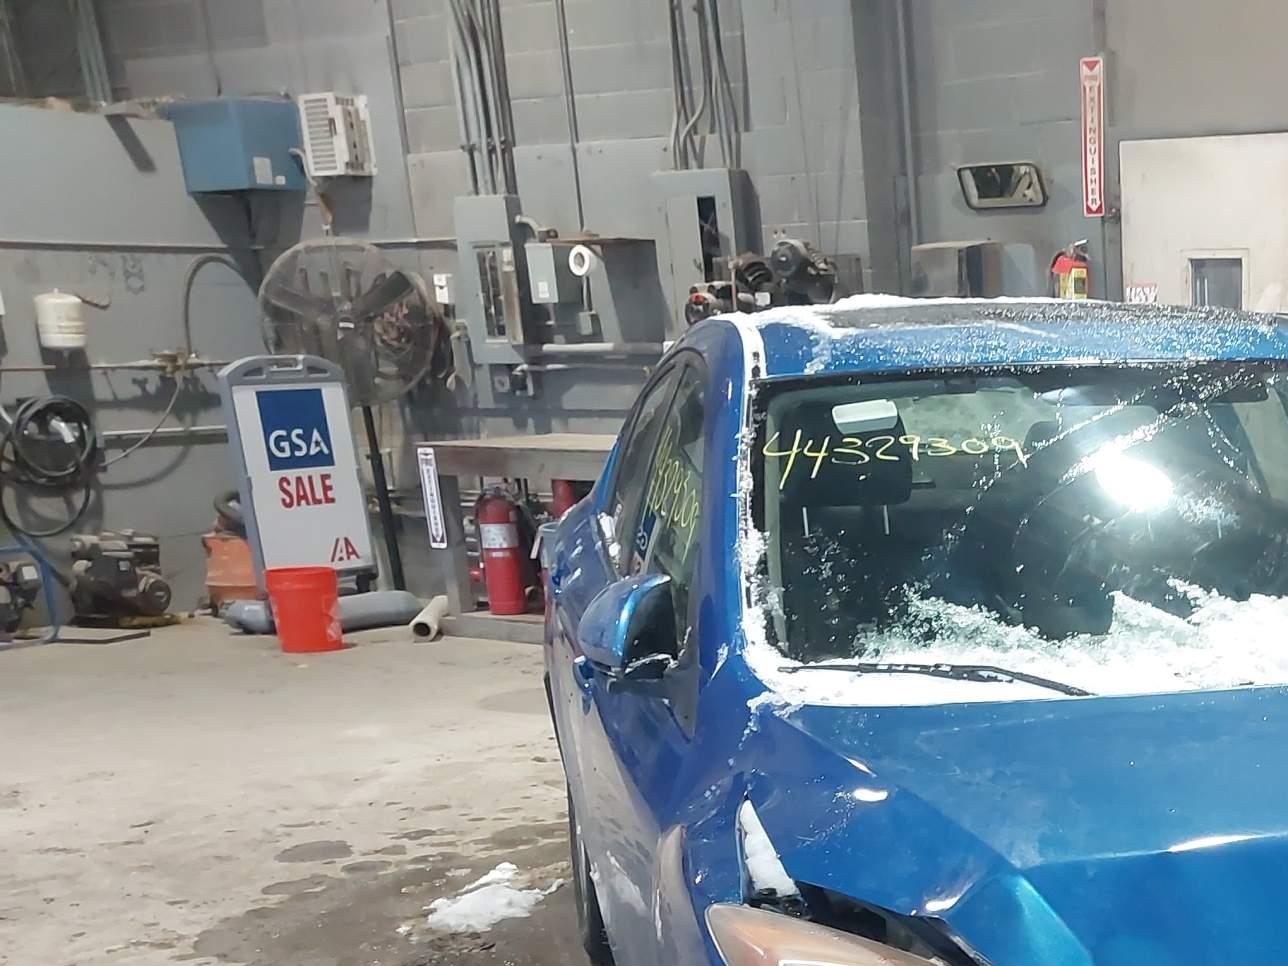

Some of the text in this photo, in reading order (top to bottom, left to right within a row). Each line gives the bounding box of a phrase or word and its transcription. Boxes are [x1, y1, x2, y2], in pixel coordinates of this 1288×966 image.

[268, 427, 330, 459] GSA
[762, 428, 1028, 490] 44329309
[278, 472, 337, 510] SALE
